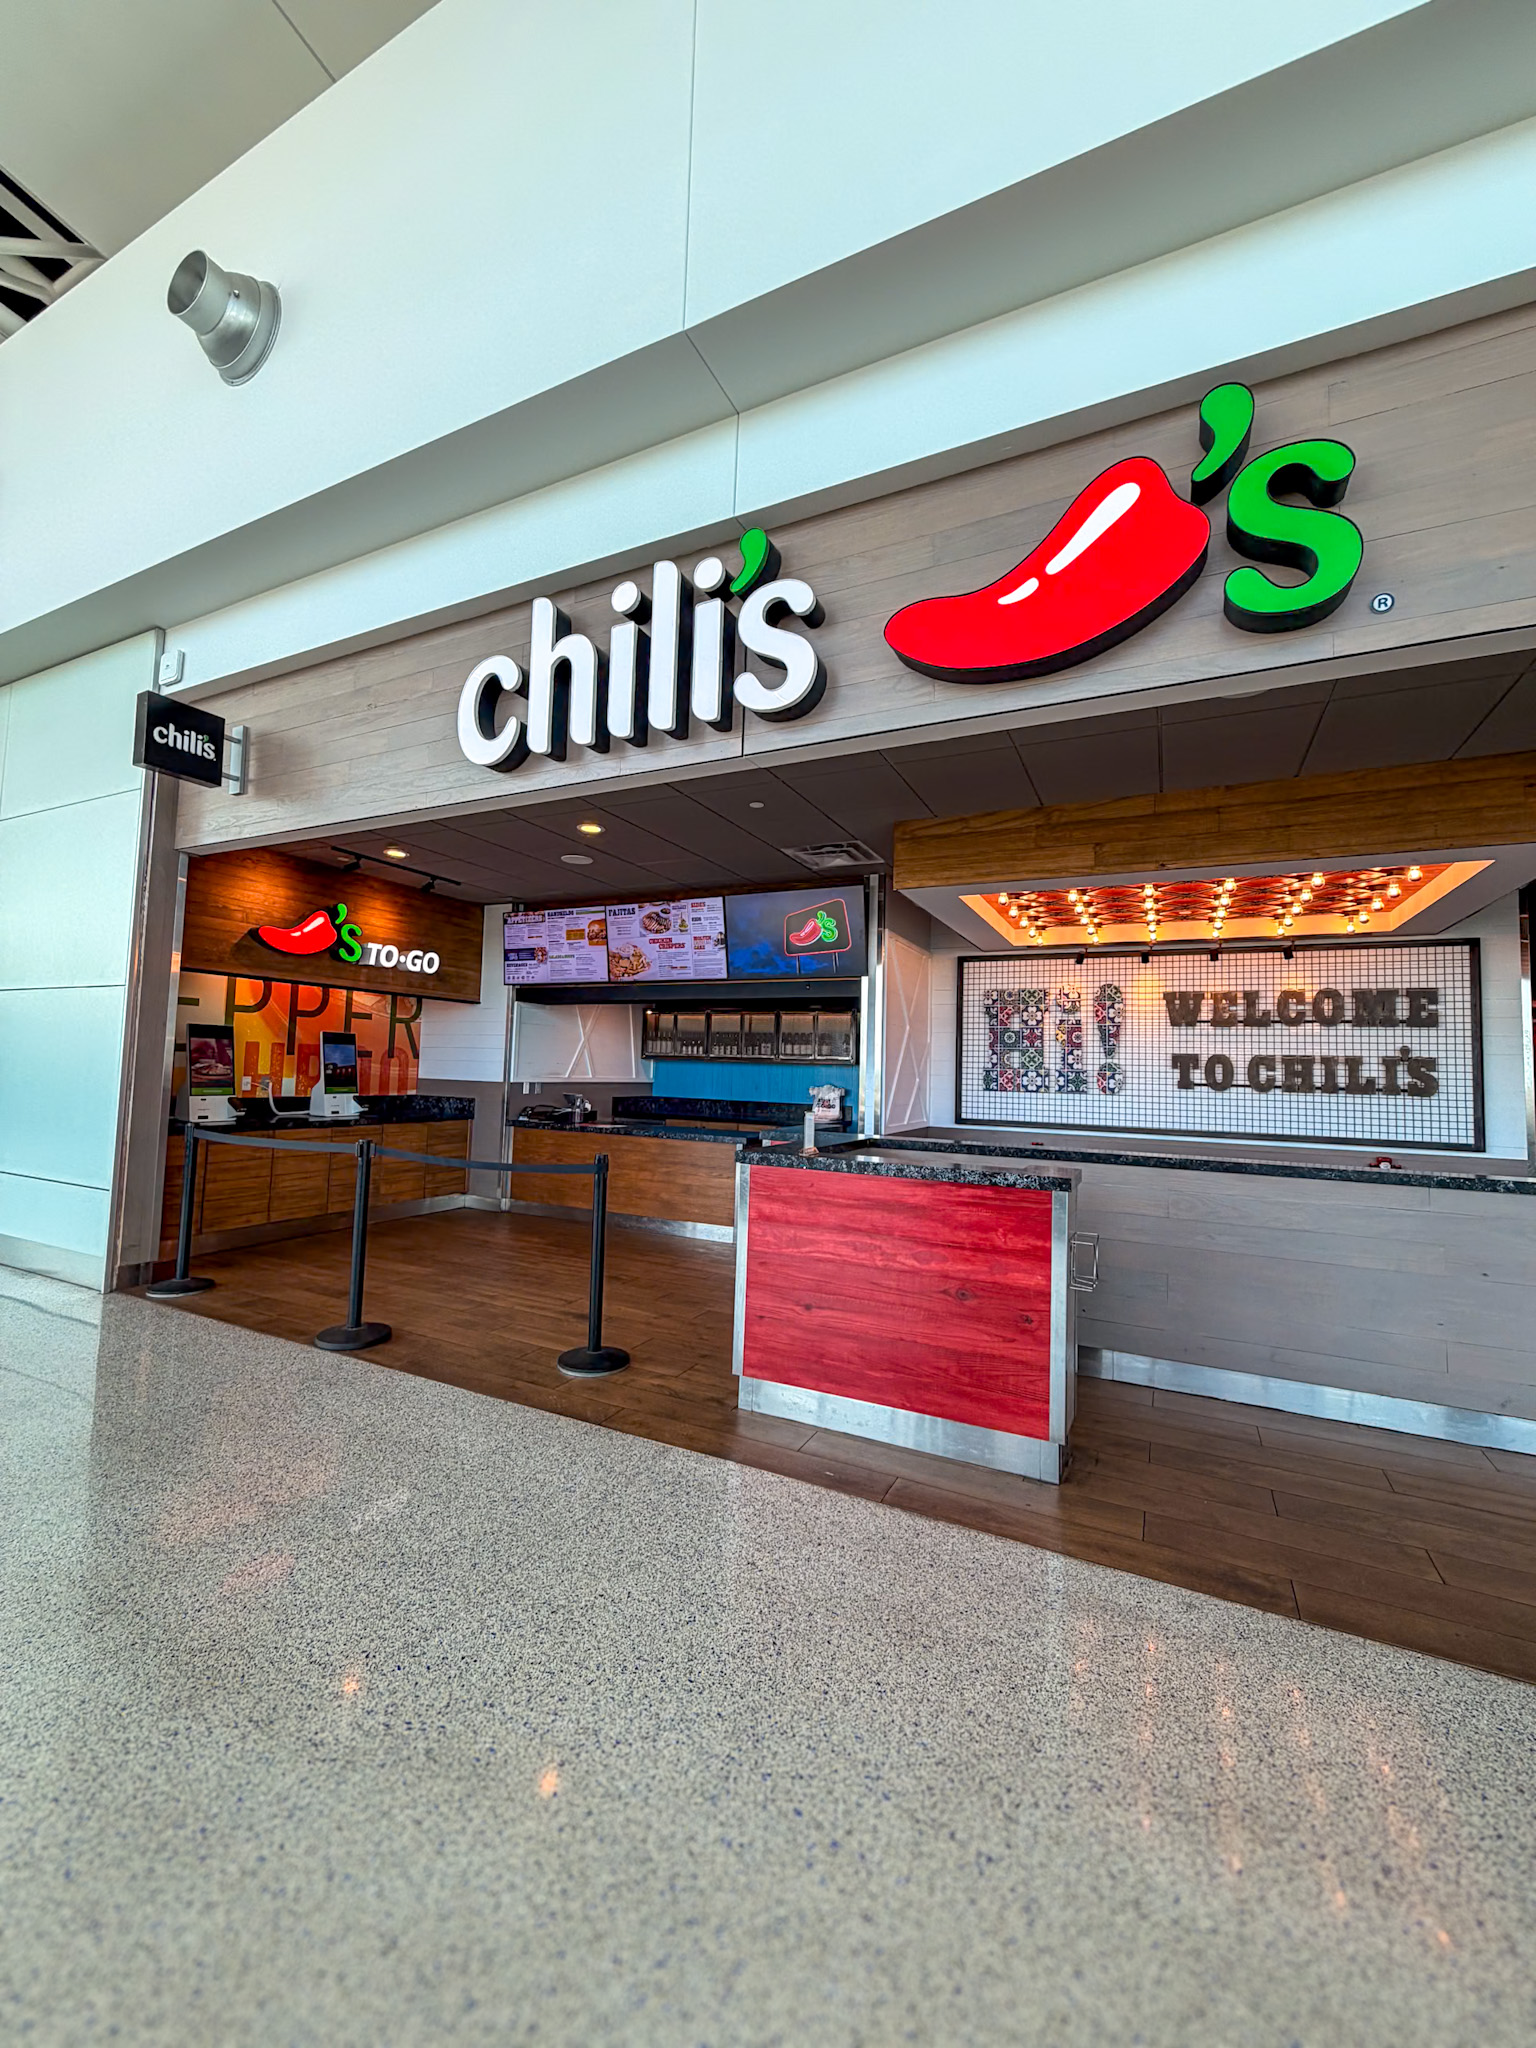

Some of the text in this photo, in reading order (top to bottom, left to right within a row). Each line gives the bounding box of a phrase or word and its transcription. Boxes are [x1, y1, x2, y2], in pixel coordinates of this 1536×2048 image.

[457, 526, 824, 770] chili's
[152, 722, 216, 761] chili's
[608, 907, 636, 917] FAJITAS
[1163, 988, 1439, 1028] WELCOME
[1171, 1045, 1439, 1098] TO CHILI'S
